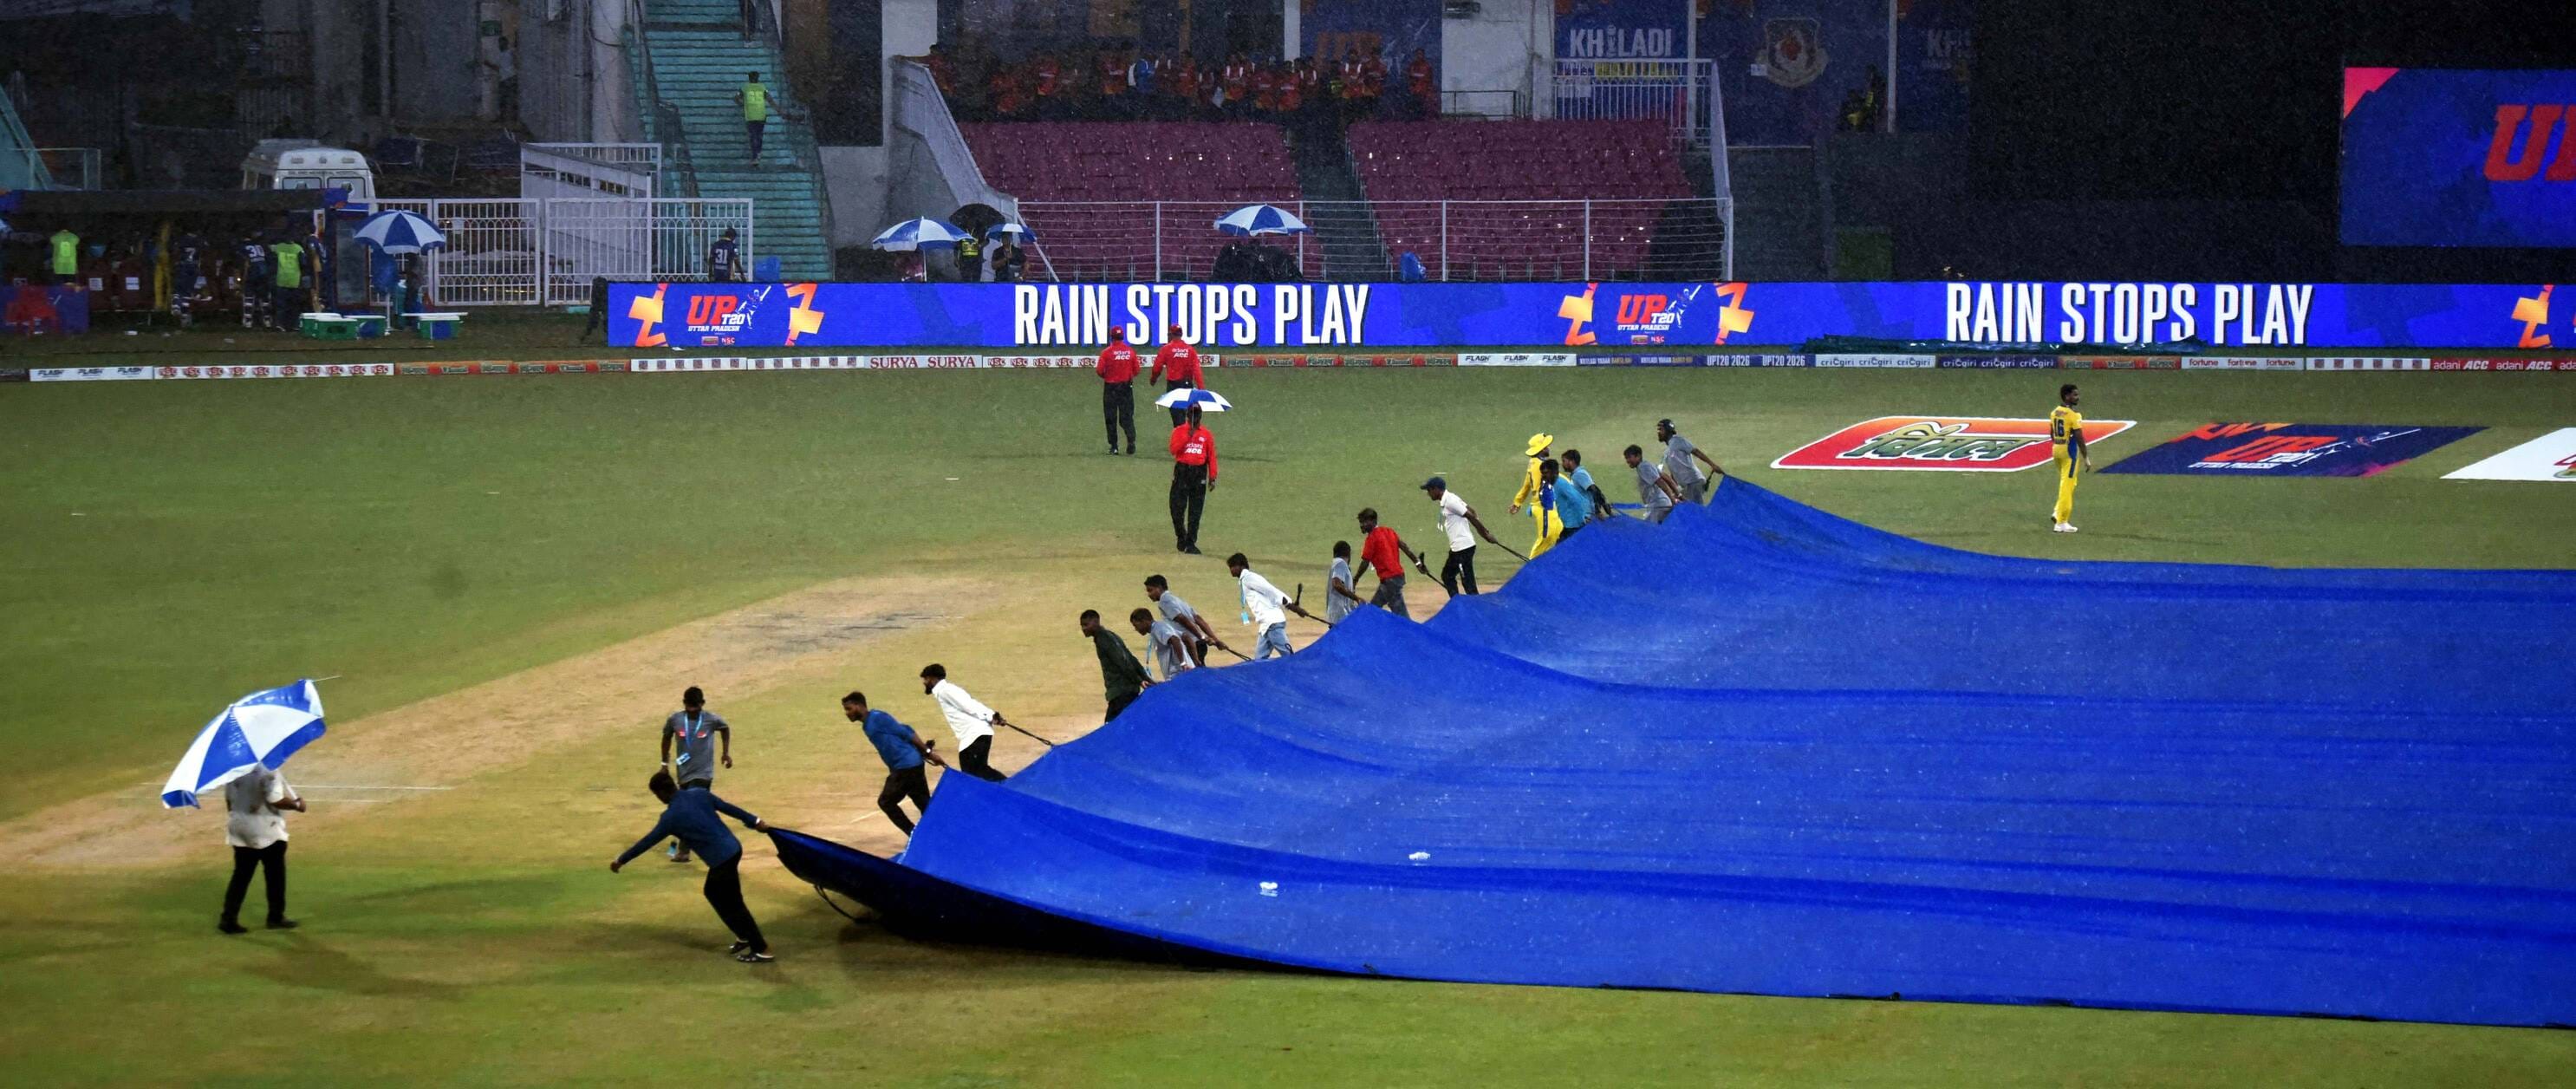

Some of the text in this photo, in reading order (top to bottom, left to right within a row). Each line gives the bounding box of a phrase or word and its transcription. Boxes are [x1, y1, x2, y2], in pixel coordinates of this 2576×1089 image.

[715, 248, 728, 264] 31
[686, 296, 738, 325] UP
[1014, 284, 1369, 345] RAIN STOPS PLAY
[1617, 295, 1667, 324] UP
[1947, 283, 2313, 344] RAIN STOPS PLAY
[721, 314, 745, 325] T20
[1651, 312, 1675, 324] T20
[870, 356, 976, 368] SURYA SURYA
[1707, 355, 1750, 366] UPT20 2026
[1762, 355, 1805, 366] UPT20 2026
[2433, 360, 2489, 369] adani ACC
[2496, 360, 2553, 369] adani ACC
[2053, 418, 2065, 438] 16
[2202, 435, 2337, 462] UP
[2258, 452, 2315, 463] T20
